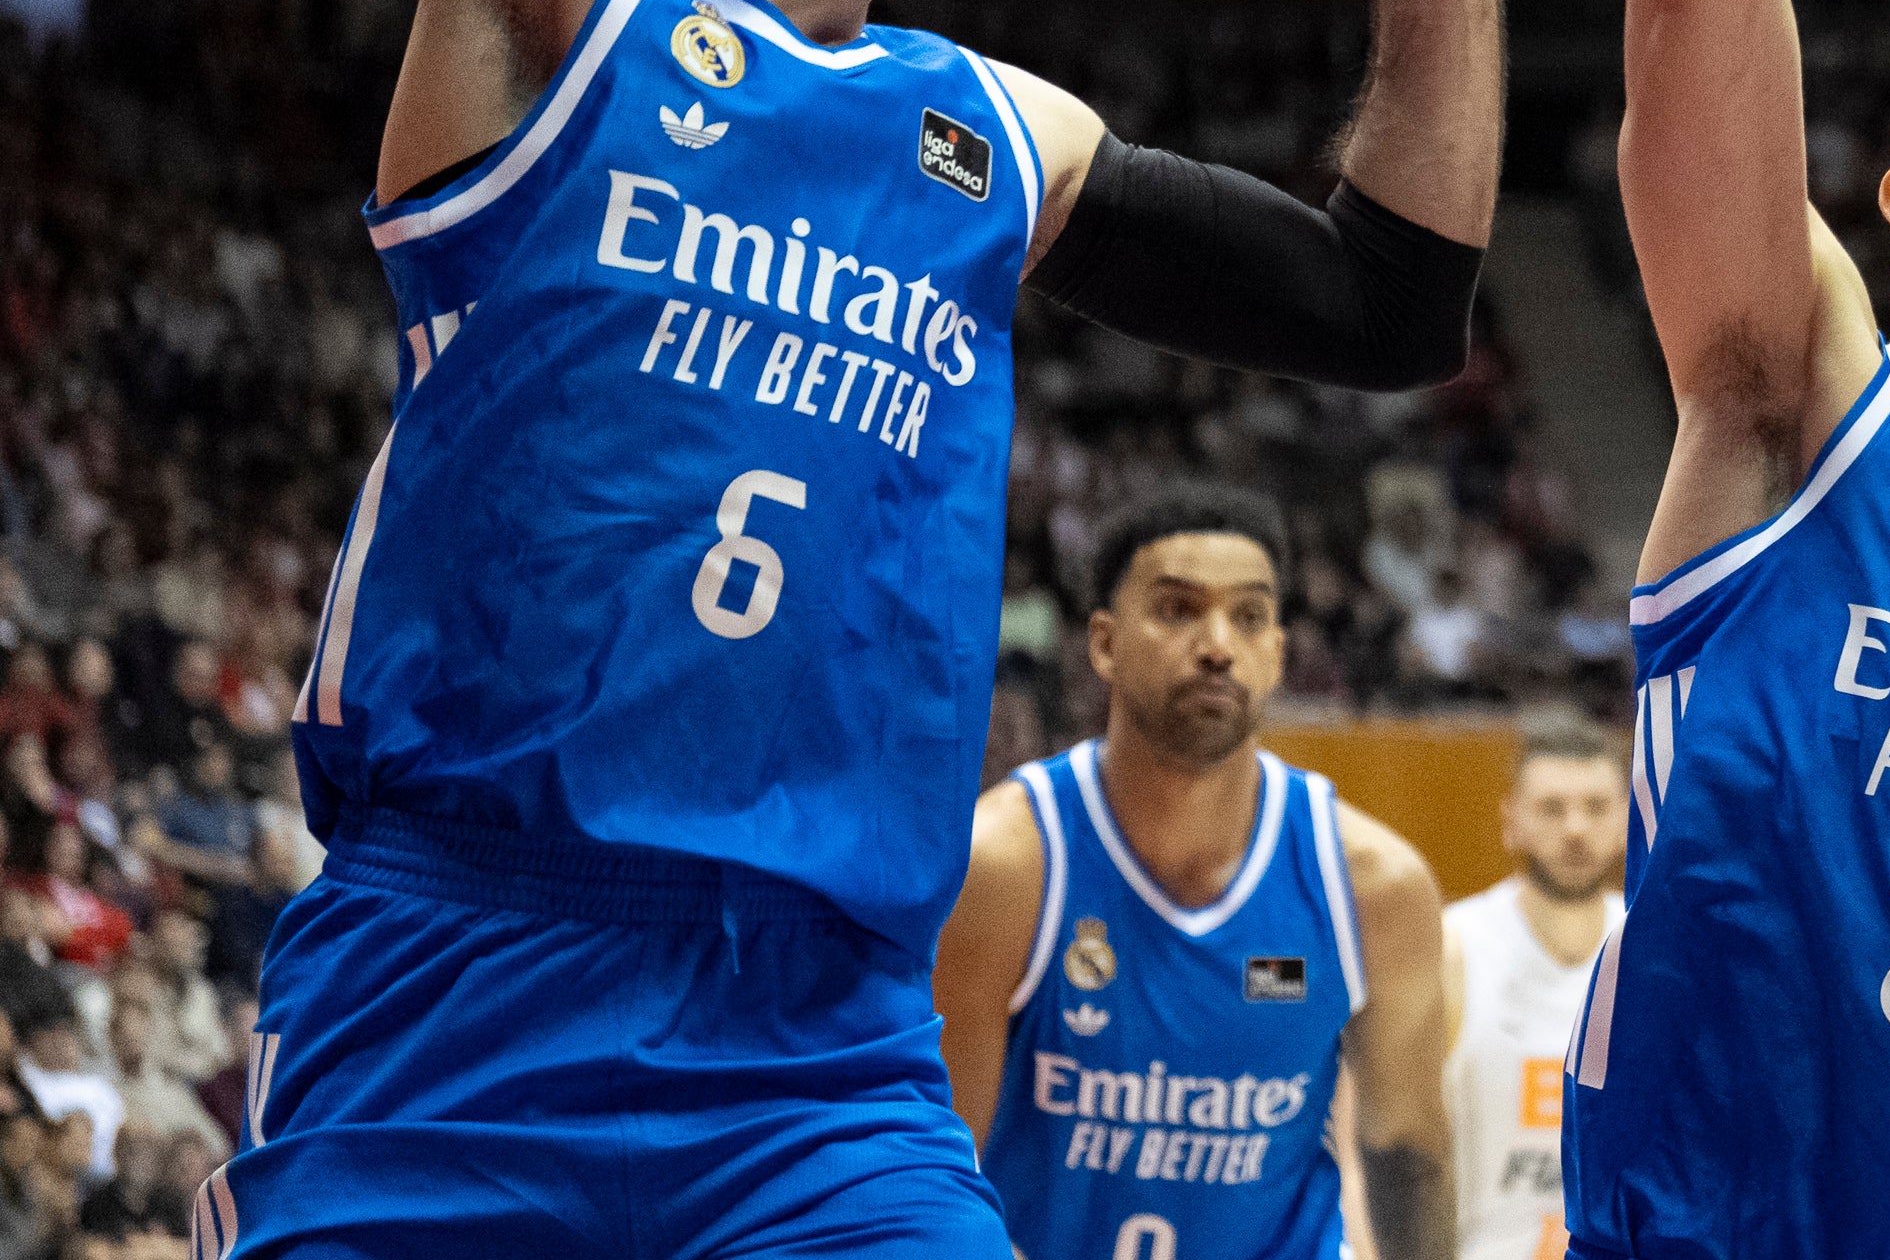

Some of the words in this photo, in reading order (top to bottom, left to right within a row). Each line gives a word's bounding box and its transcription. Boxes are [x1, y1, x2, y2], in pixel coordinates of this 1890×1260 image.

[923, 151, 983, 192] endesa
[924, 130, 955, 156] liga
[597, 170, 978, 387] Emirates
[639, 299, 754, 391] FLY
[754, 333, 932, 459] BETTER
[691, 469, 807, 640] 6
[1034, 1051, 1311, 1129] Emirates
[1065, 1123, 1137, 1174] FLY
[1134, 1128, 1272, 1186] BETTER
